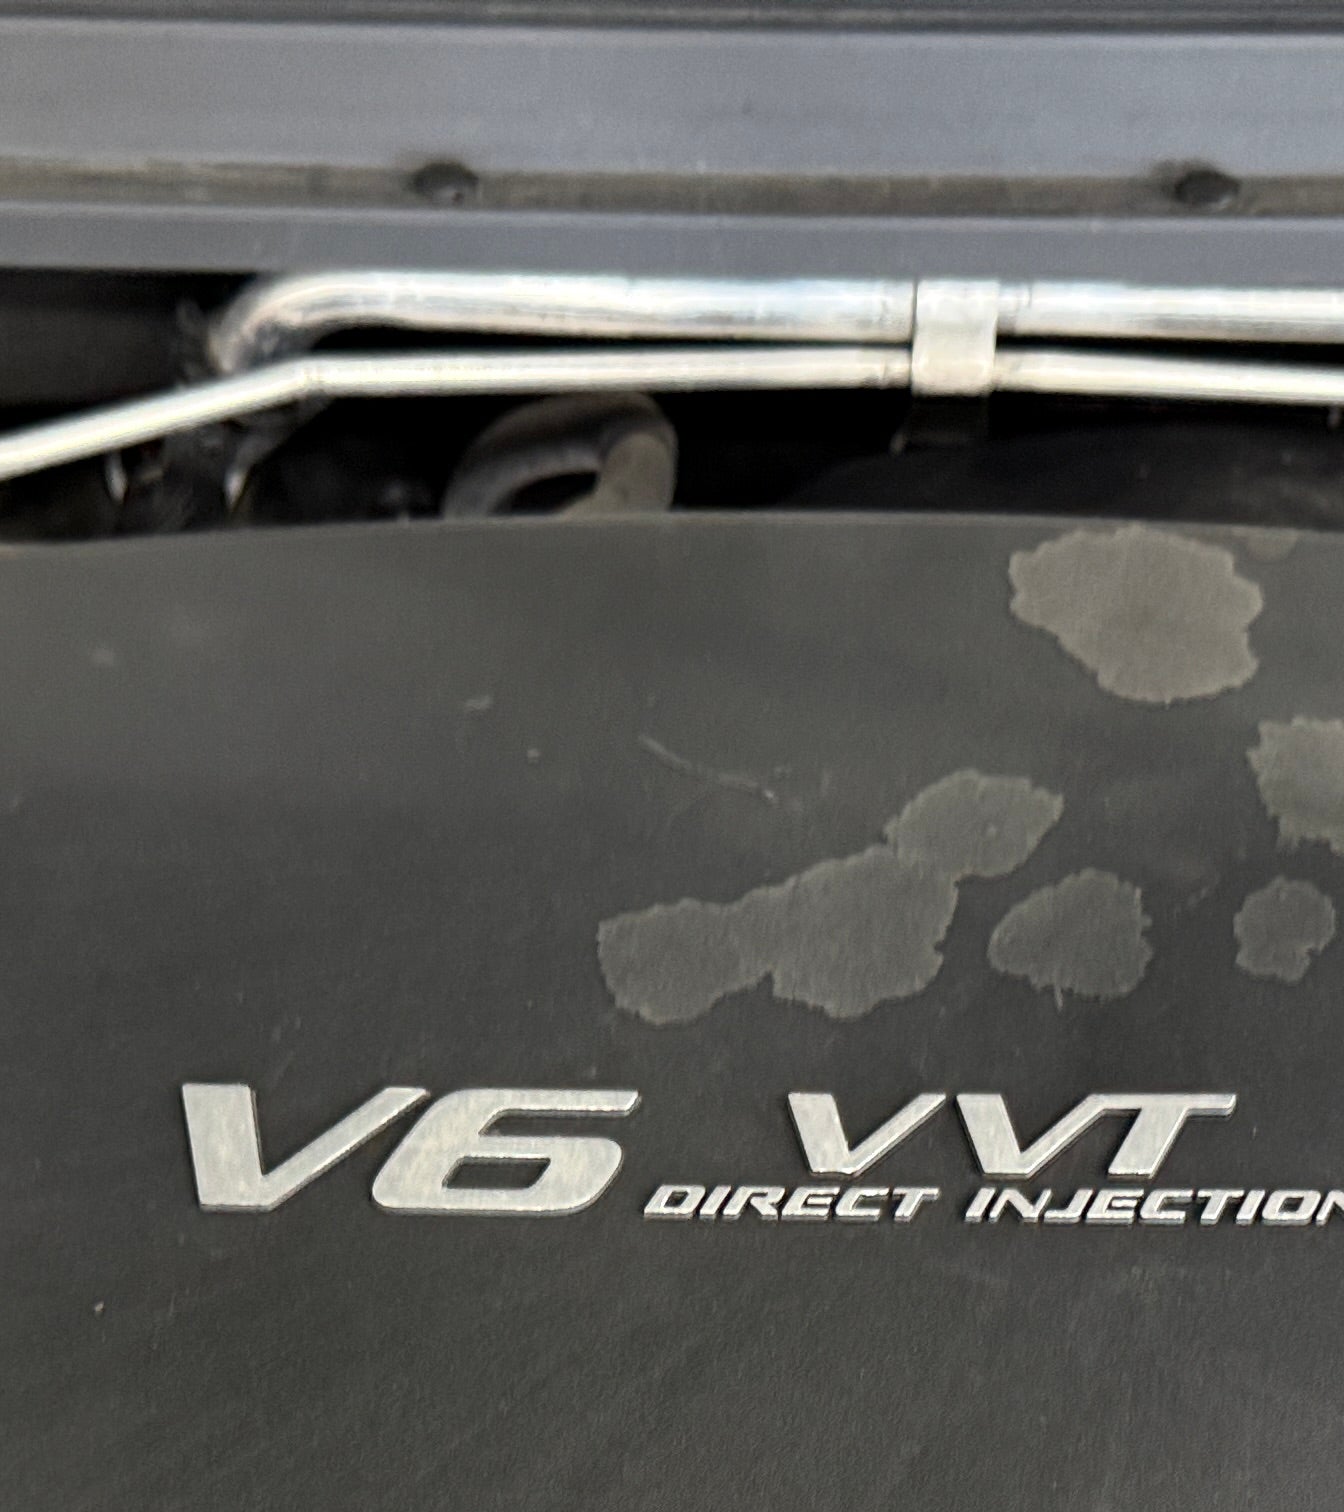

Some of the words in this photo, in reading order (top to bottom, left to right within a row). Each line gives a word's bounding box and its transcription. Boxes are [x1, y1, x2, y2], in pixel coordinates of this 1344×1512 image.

[182, 1082, 640, 1216] V6
[788, 1092, 1237, 1180] VVT
[643, 1184, 940, 1221] DIRECT
